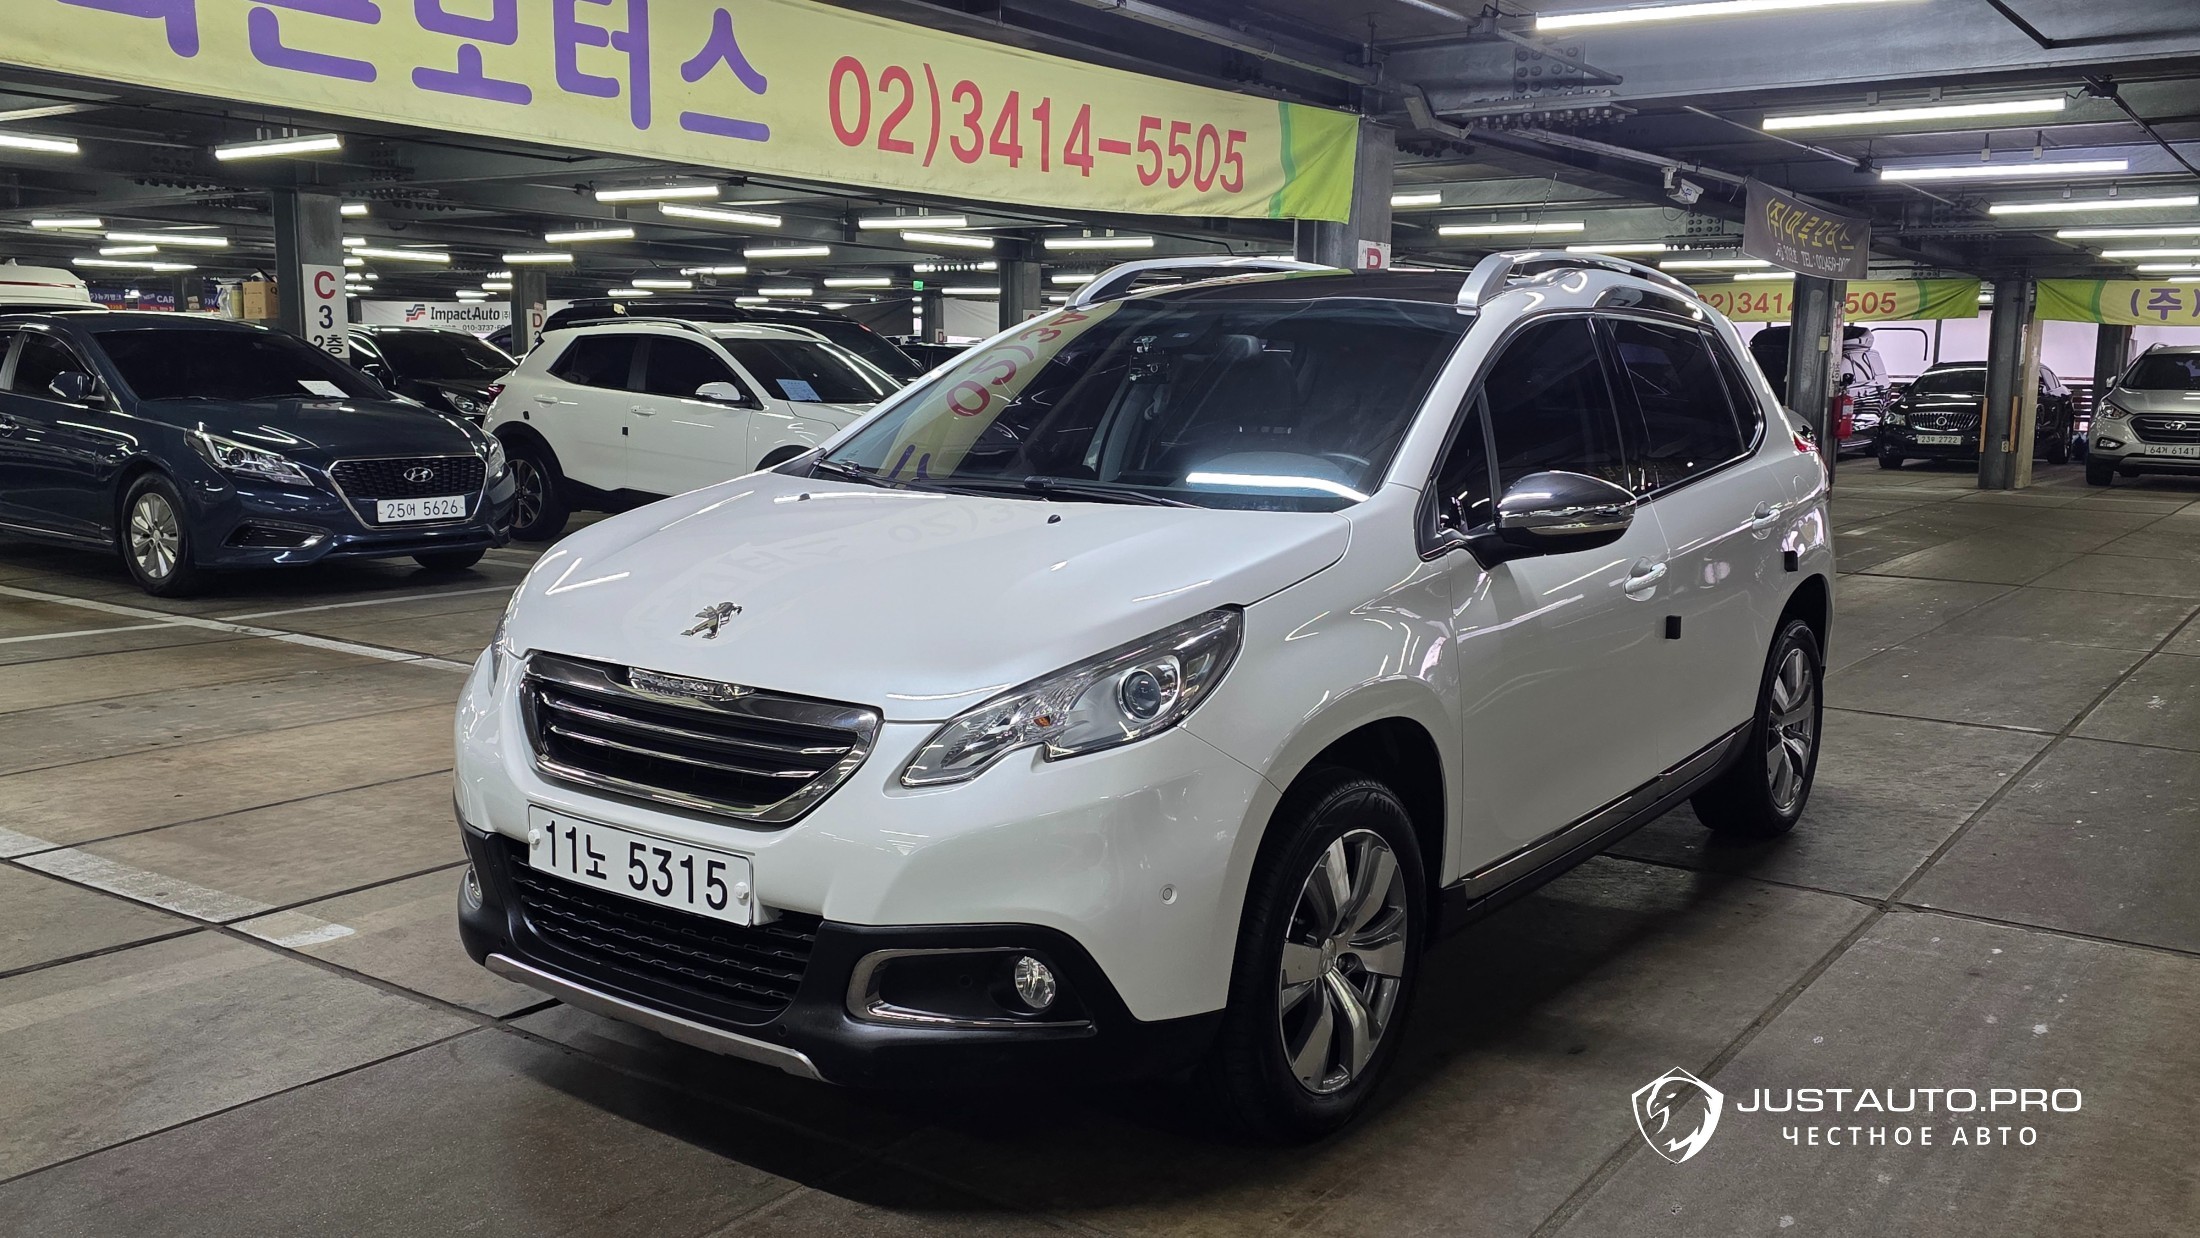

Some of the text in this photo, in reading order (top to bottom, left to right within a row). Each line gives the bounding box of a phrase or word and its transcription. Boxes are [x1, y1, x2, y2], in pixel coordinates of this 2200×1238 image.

[828, 55, 1248, 194] 02)3414-5505
[314, 270, 336, 299] C
[156, 295, 175, 304] CAR
[2130, 288, 2200, 320] (주)
[319, 305, 334, 329] 3
[532, 313, 543, 328] D
[2171, 446, 2194, 455] 6141
[386, 499, 458, 519] 25어 5626
[546, 820, 728, 911] 11노 5315
